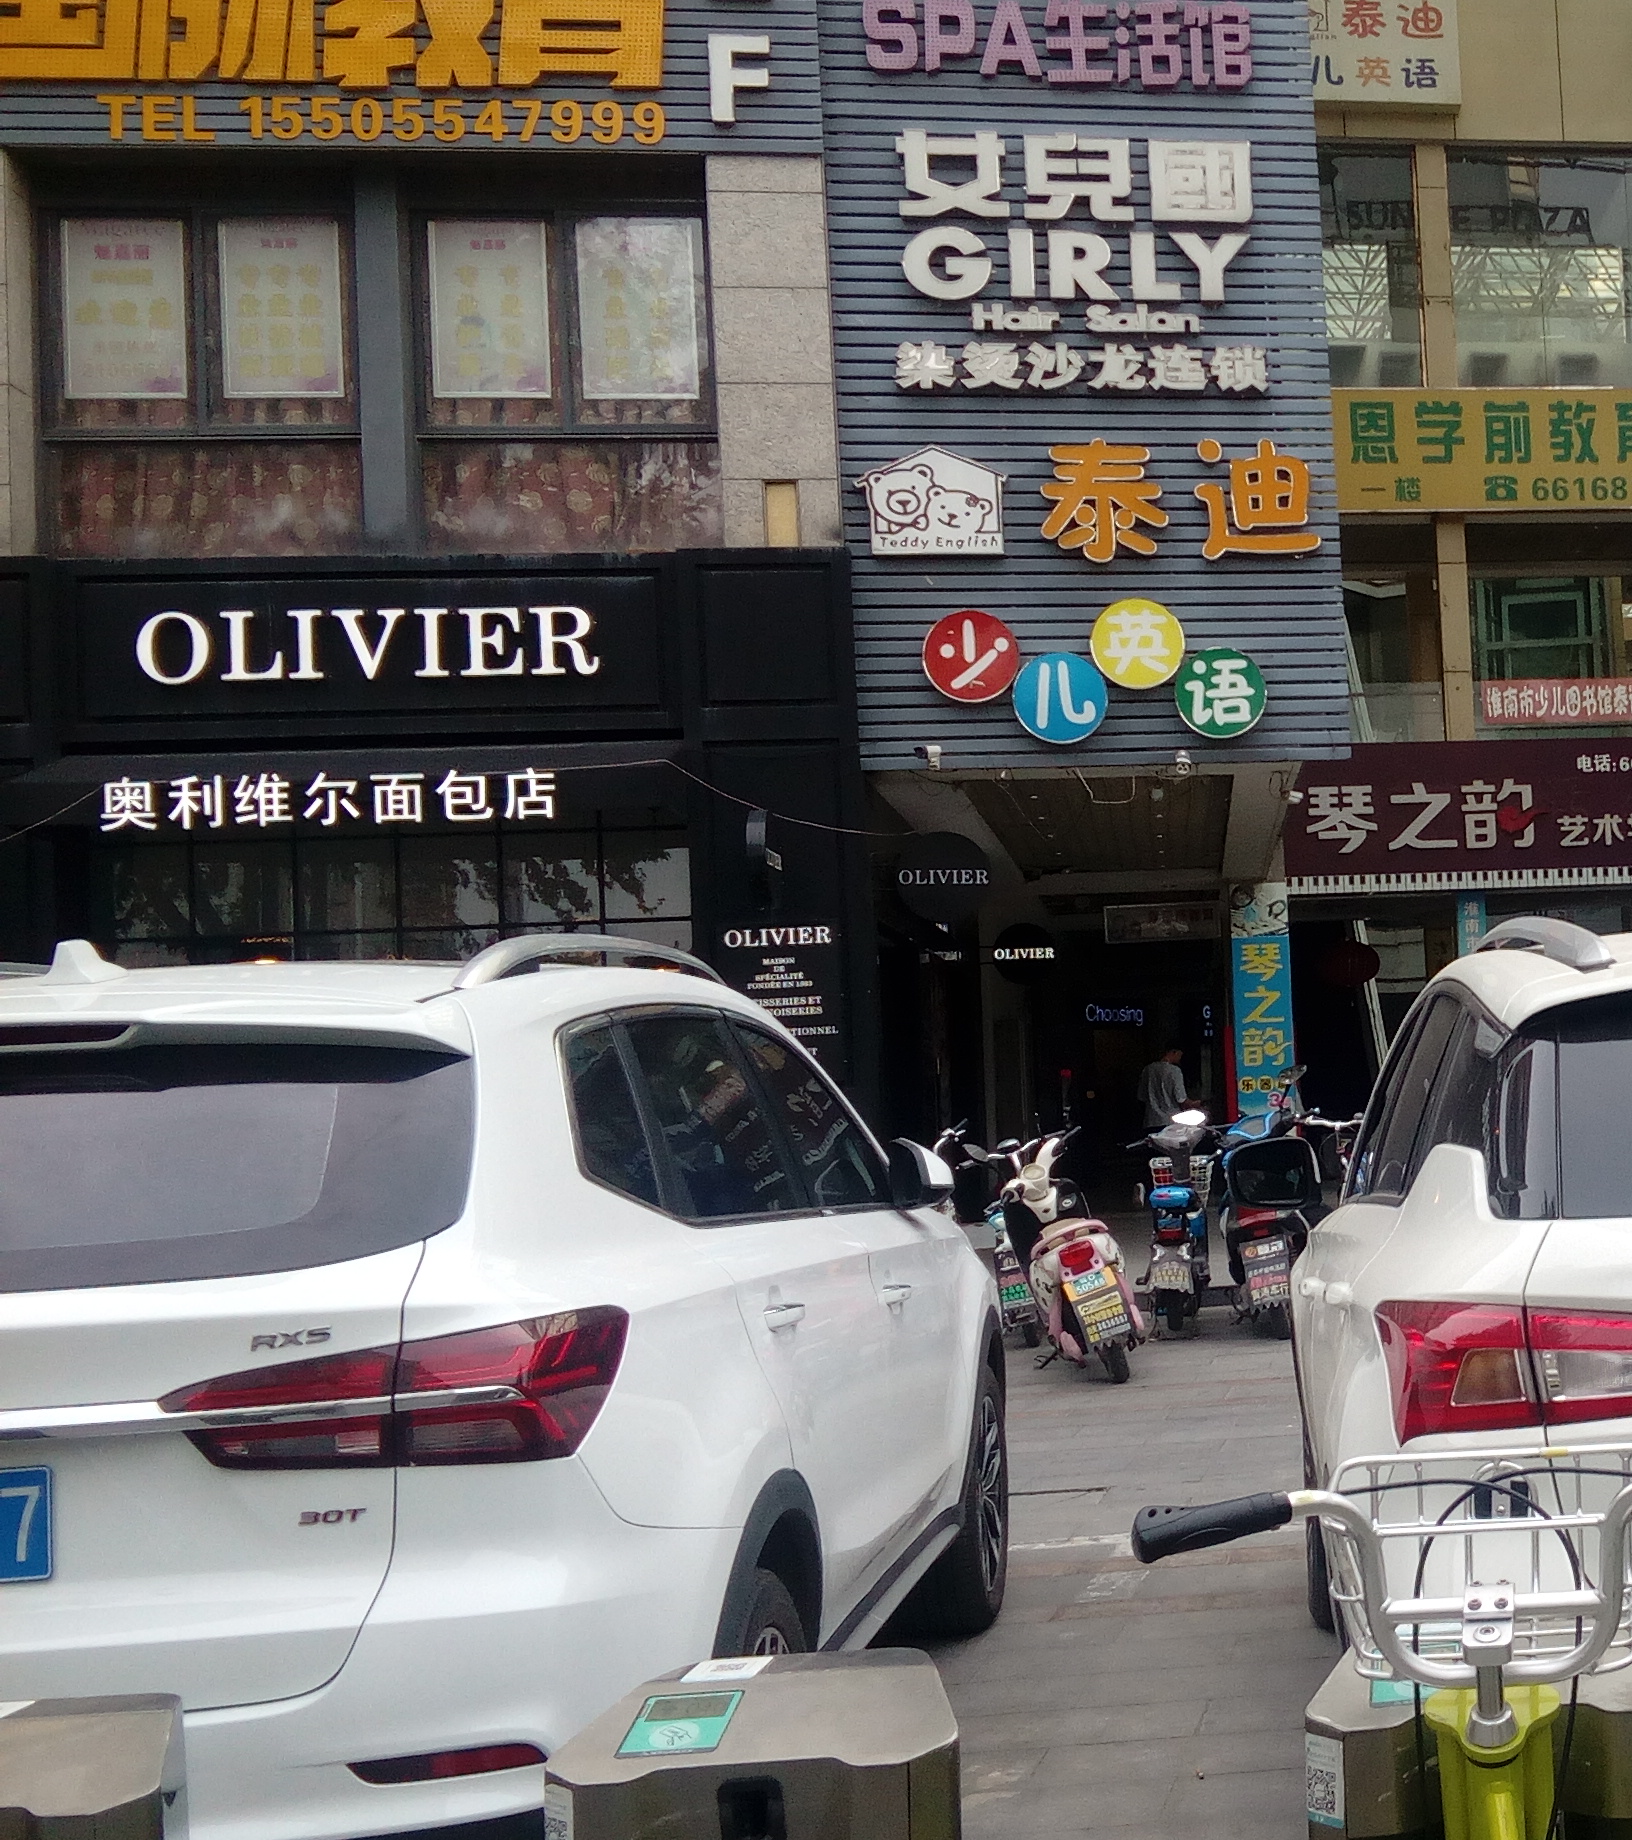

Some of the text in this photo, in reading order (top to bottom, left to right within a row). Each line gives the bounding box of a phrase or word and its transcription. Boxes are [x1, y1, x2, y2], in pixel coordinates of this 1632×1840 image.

[1341, 0, 1444, 39] 泰迪
[863, 0, 1253, 90] SPA生活馆
[708, 35, 771, 125] F
[98, 94, 668, 145] TEL 15505547999
[902, 226, 1251, 302] GIRLY
[971, 303, 1204, 333] Hair Salon
[895, 340, 1270, 394] 染烫沙龙连锁
[1040, 438, 1322, 564] 泰迪
[1361, 477, 1422, 505] 一楼
[879, 536, 998, 550] Teddy English
[136, 606, 600, 685] OLIVIER
[100, 768, 558, 832] 奥利维尔面包店
[1306, 778, 1536, 854] 琴之韵
[898, 869, 989, 885] OLIVIER
[724, 926, 832, 948] OLIVIER
[994, 947, 1055, 960] OLIVIER
[1085, 1004, 1144, 1026] Choosing
[1240, 943, 1292, 1066] 琴之韵
[250, 1327, 332, 1351] RX5
[298, 1507, 366, 1526] 30T
